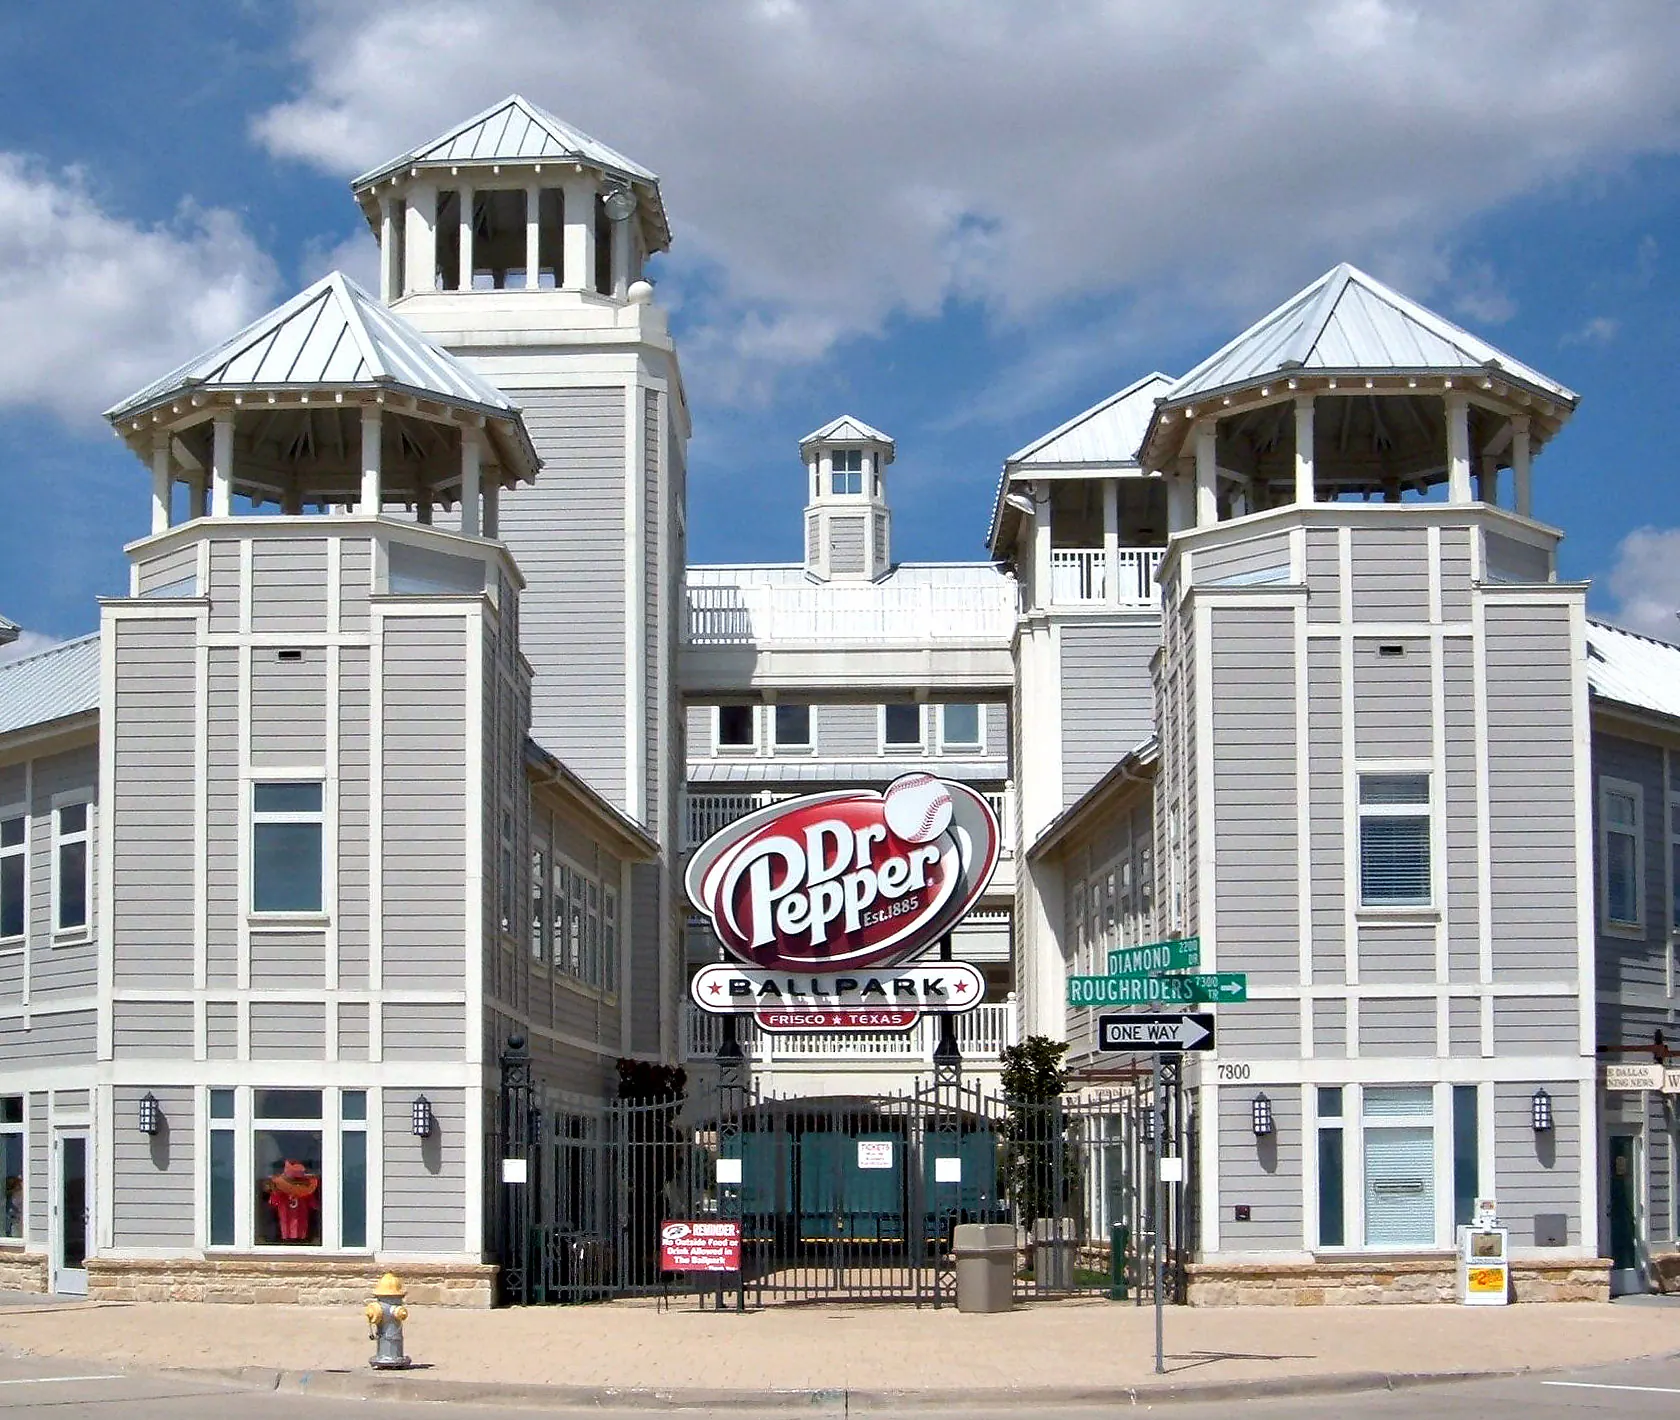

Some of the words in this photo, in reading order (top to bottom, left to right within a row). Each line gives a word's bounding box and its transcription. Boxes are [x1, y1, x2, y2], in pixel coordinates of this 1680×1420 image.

[803, 819, 886, 888] Dr
[731, 836, 940, 948] Pepper
[1109, 946, 1171, 975] DIAMOND
[1188, 953, 1198, 965] DR
[729, 977, 946, 997] BALLPARK
[1195, 976, 1218, 988] 7300
[1071, 978, 1193, 1001] ROUGHRIDERS
[1208, 989, 1218, 1000] TR
[769, 1014, 825, 1025] FRISCO
[849, 1014, 902, 1025] TEXAS
[1111, 1026, 1142, 1040] ONE
[1147, 1025, 1180, 1040] WAY
[1217, 1064, 1251, 1080] 7300
[1616, 1068, 1649, 1077] DALLAS
[692, 1223, 736, 1236] REMINDER
[675, 1238, 707, 1246] Outside
[707, 1238, 728, 1246] Food
[667, 1247, 689, 1255] Drink
[690, 1247, 724, 1256] Allowed
[673, 1256, 690, 1264] The
[691, 1256, 726, 1265] Ballpark
